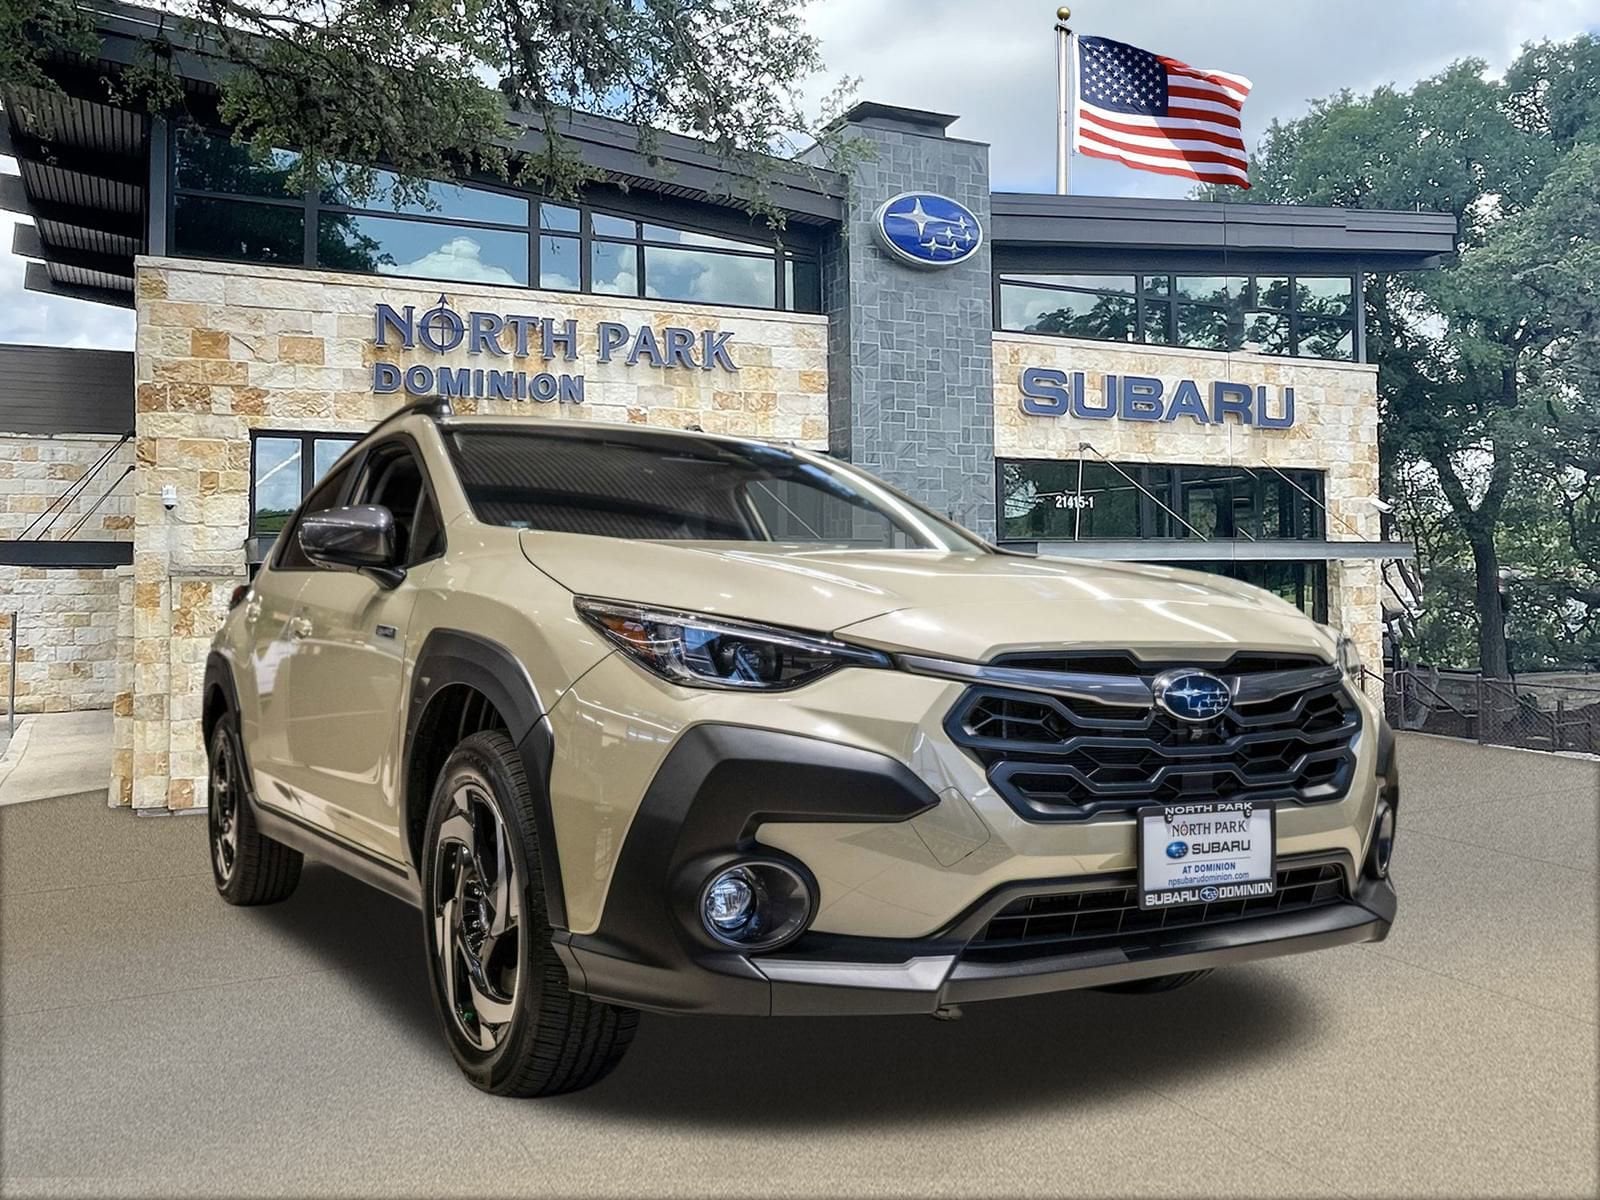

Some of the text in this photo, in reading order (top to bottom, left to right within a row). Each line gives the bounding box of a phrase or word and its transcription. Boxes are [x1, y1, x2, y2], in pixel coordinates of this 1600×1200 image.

[374, 293, 741, 373] NORTH PARK
[373, 362, 586, 404] DOMINION
[1018, 367, 1294, 429] SUBARU
[1164, 802, 1253, 815] NORTH PARK
[1171, 820, 1247, 837] NORTH PARK
[1191, 840, 1251, 855] SUBARU
[1182, 862, 1236, 875] AT DOMINION
[1167, 872, 1250, 888] npsubarudominion.com
[1145, 882, 1273, 906] SUBARU DOMINION
